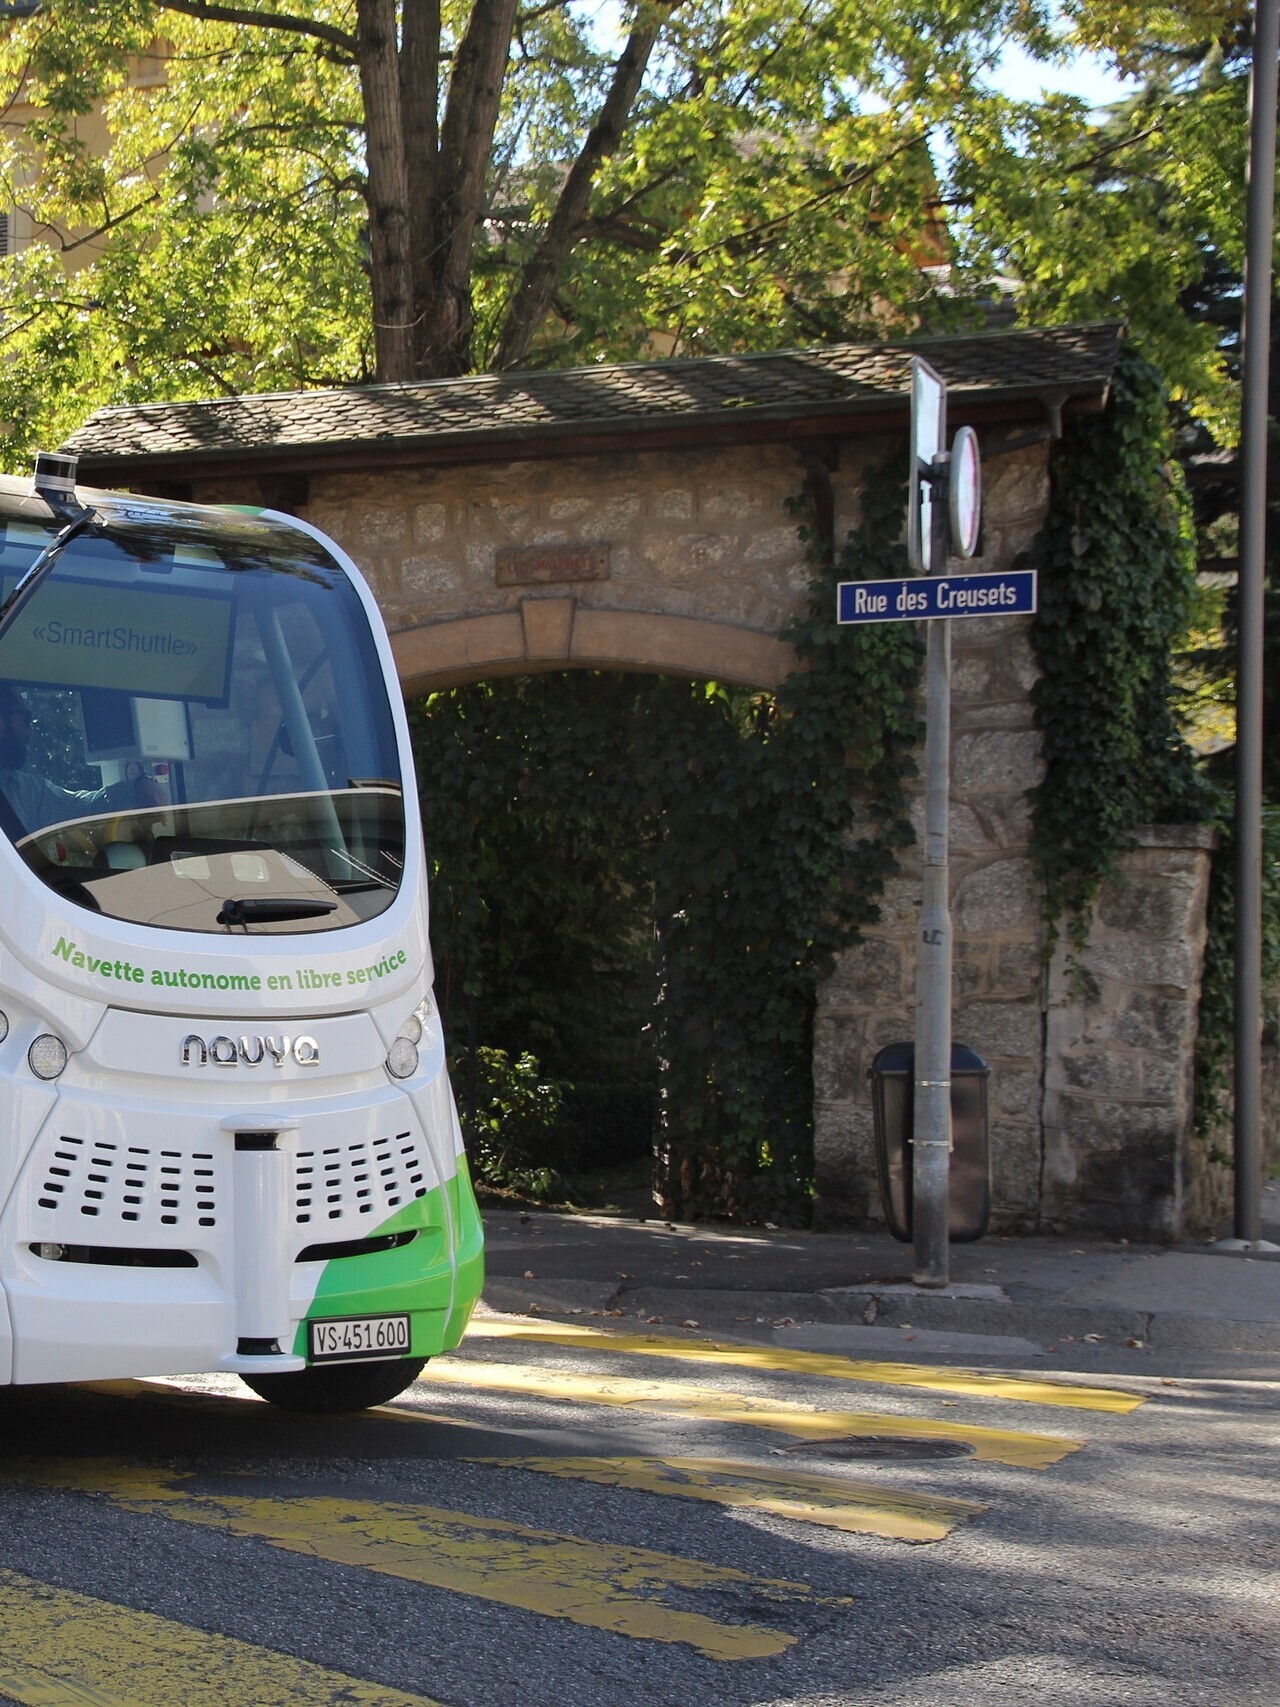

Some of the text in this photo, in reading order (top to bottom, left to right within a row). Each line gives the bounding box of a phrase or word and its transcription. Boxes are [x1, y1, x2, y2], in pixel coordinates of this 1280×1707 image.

[854, 581, 1017, 614] Rue des Creusets
[32, 620, 198, 658] «SmartShuttle»
[51, 936, 408, 991] Navette autonome en libre service
